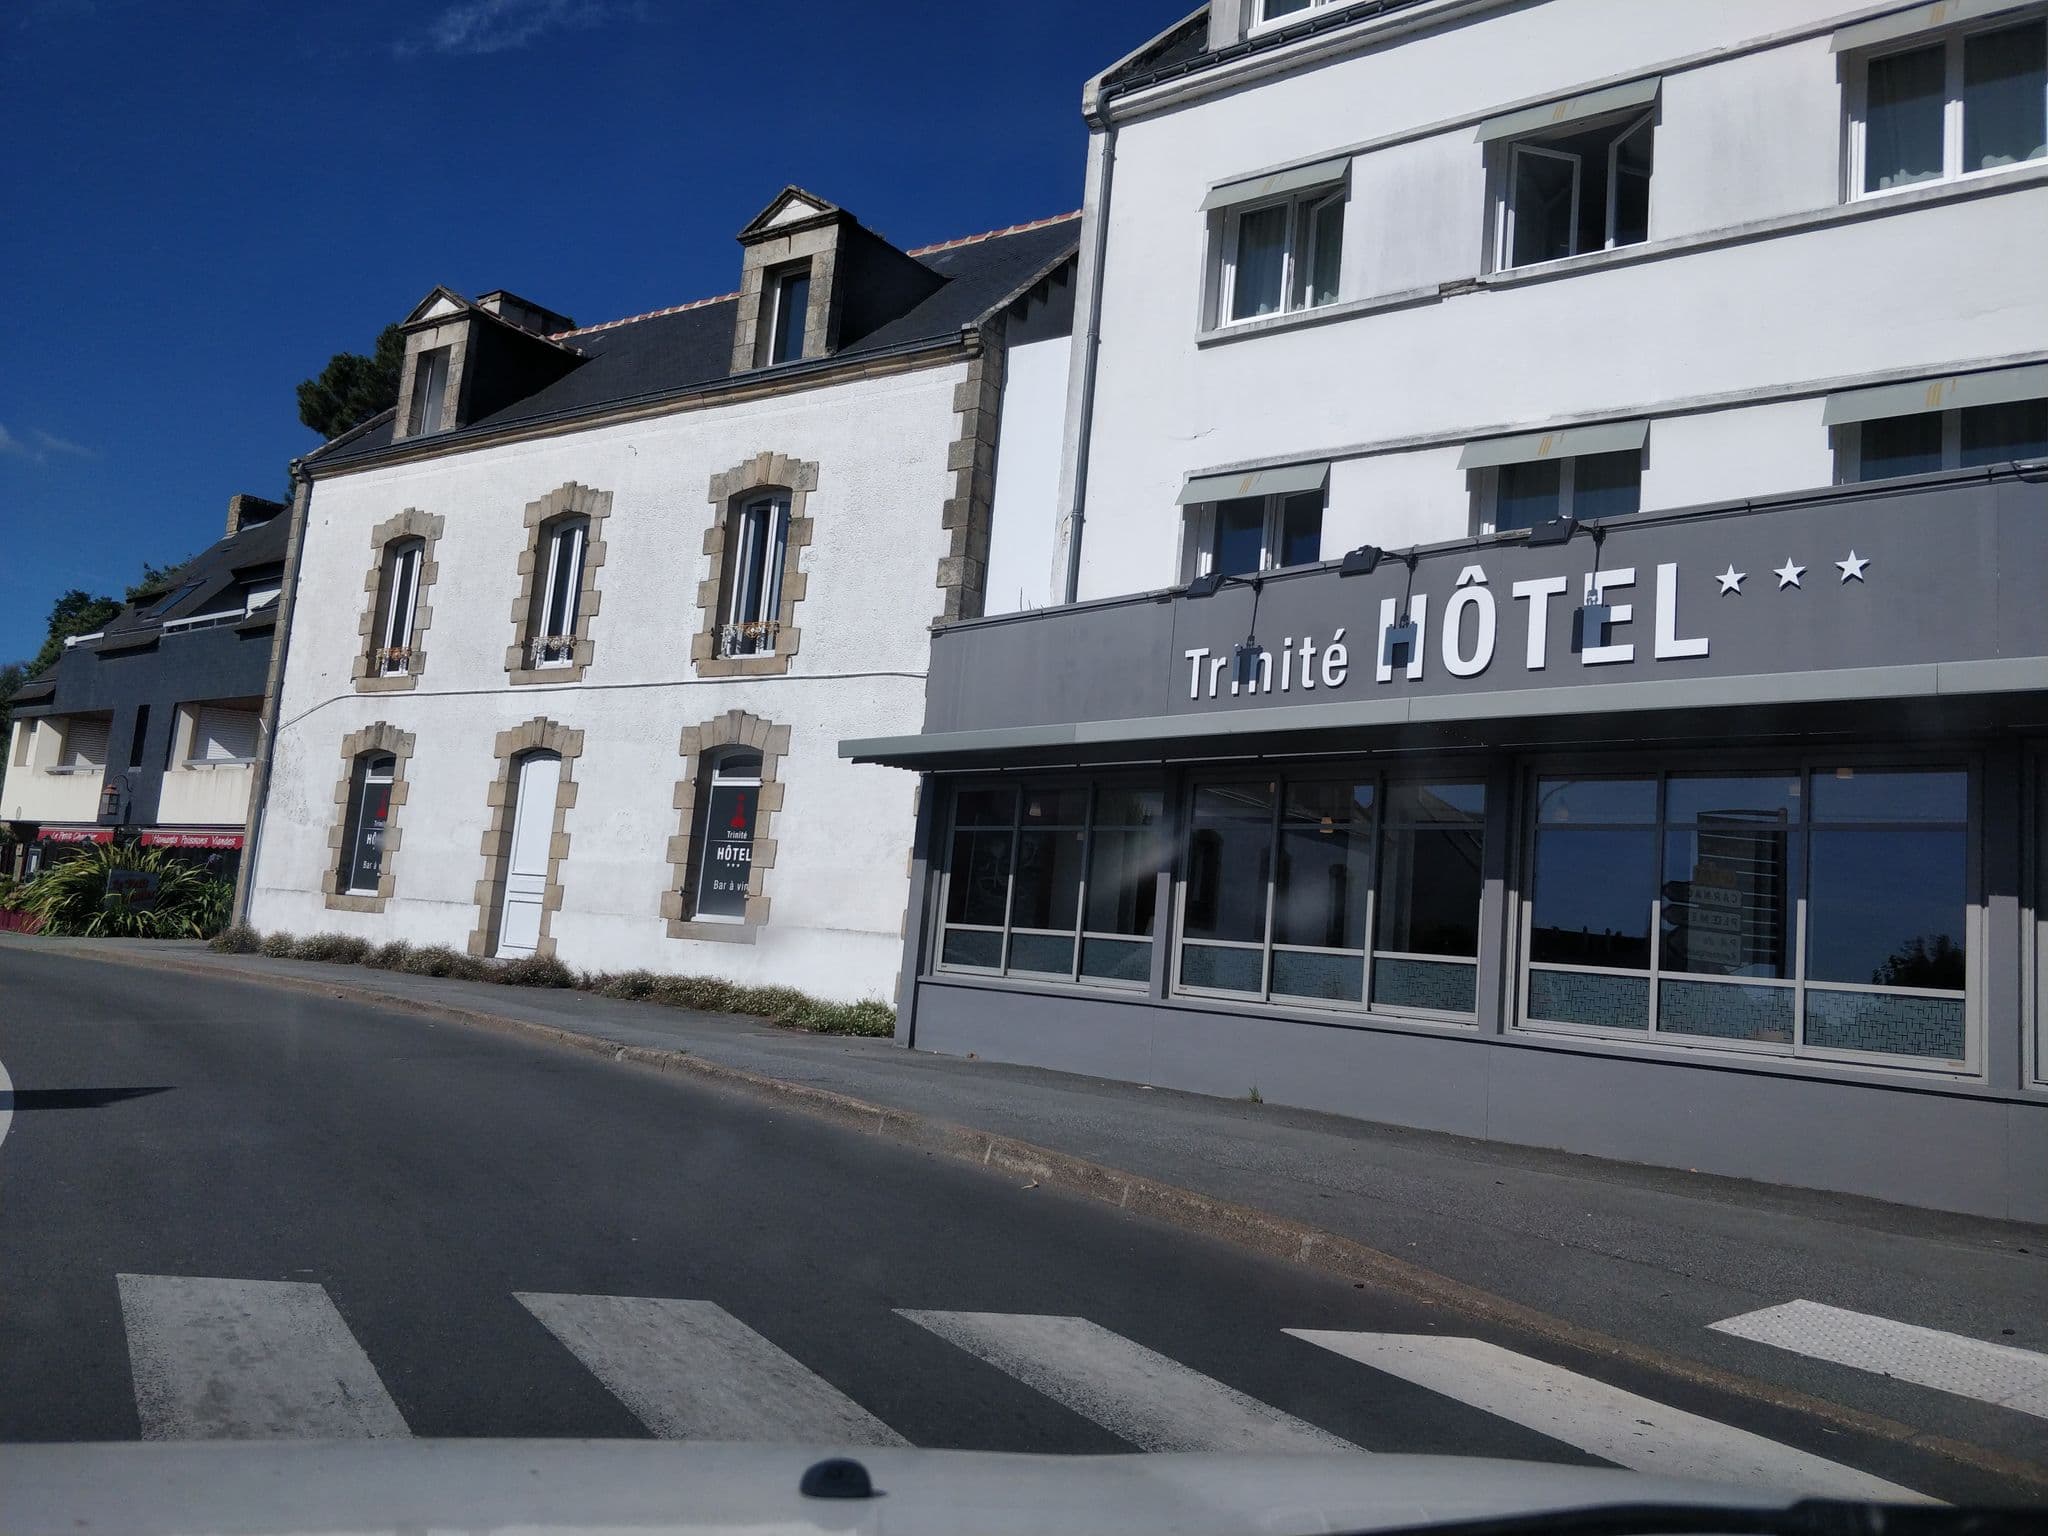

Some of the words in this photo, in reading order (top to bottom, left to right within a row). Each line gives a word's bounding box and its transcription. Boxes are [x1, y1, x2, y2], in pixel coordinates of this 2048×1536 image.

[1185, 628, 1348, 699] Trinité
[1376, 563, 1710, 683] HÔTEL
[727, 830, 748, 839] Trinité
[181, 835, 209, 846] Poissons
[212, 836, 236, 848] Viandes
[717, 844, 753, 861] HÔTEL
[713, 879, 727, 889] Bar
[729, 880, 734, 891] à
